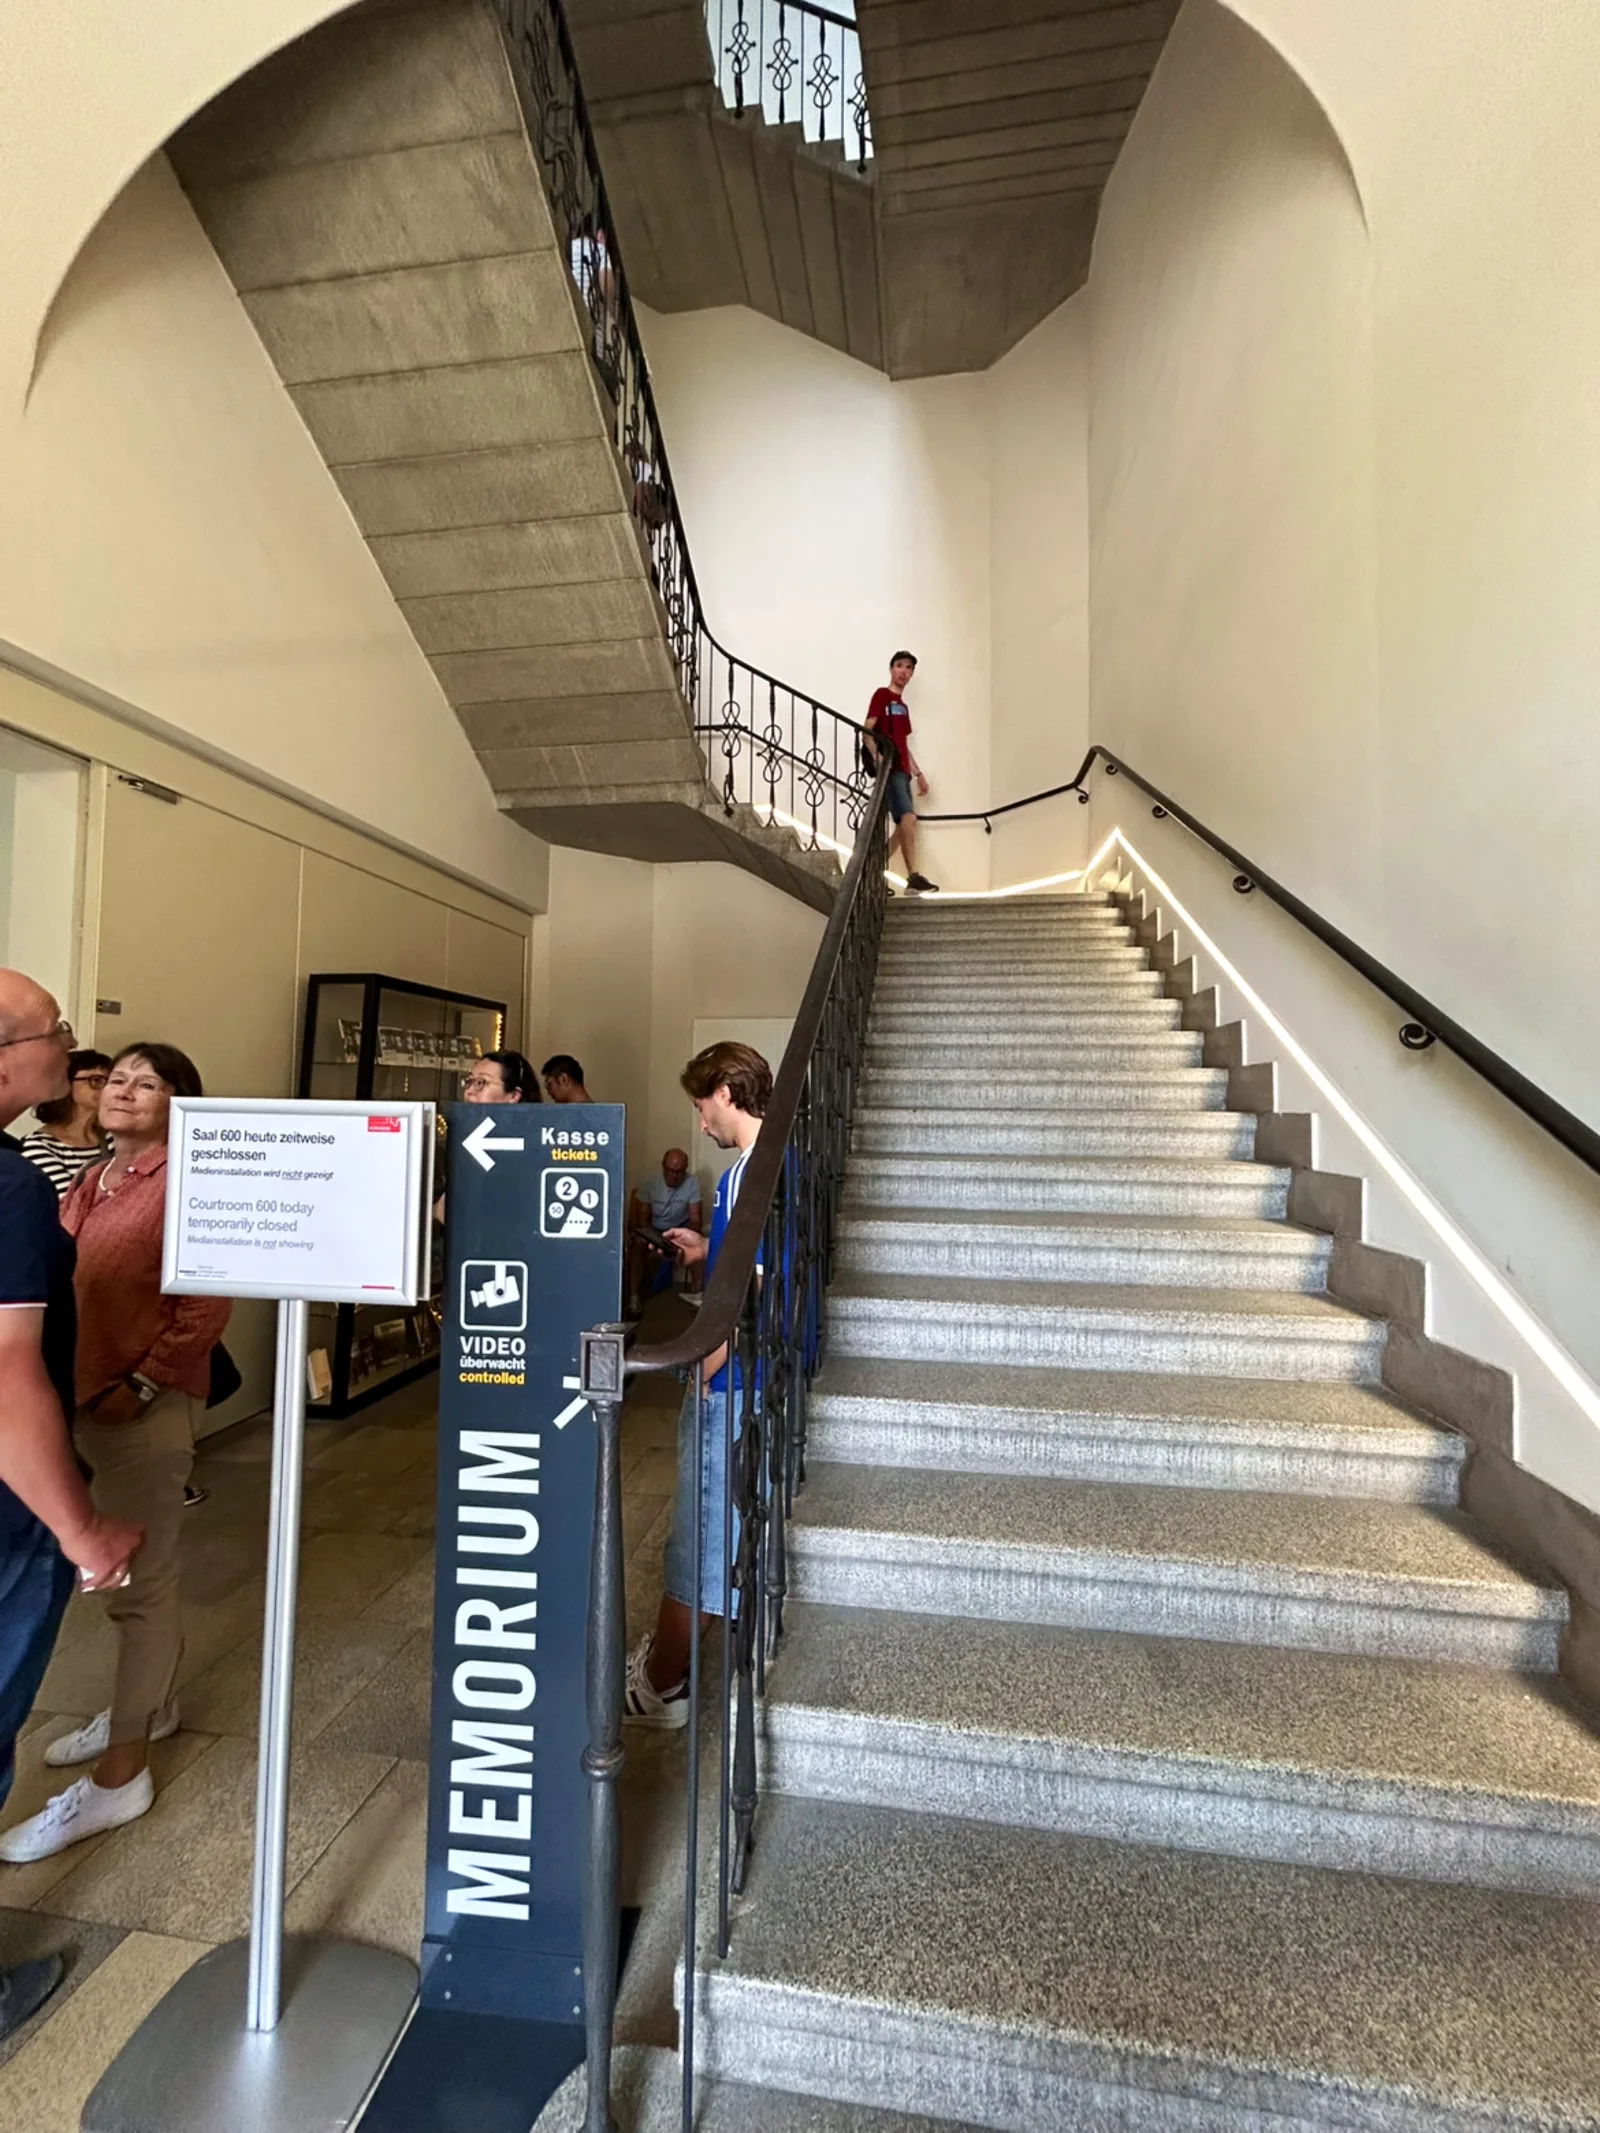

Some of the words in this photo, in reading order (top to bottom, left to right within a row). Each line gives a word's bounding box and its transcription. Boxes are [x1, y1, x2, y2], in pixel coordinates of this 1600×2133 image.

[192, 1128, 217, 1143] Saal
[220, 1130, 241, 1143] 600
[244, 1130, 277, 1144] heute
[279, 1131, 335, 1145] zeitweise
[541, 1127, 610, 1146] Kasse
[191, 1147, 267, 1162] geschlossen
[551, 1148, 598, 1161] tickets
[190, 1166, 262, 1178] Medieninstallation
[263, 1168, 281, 1178] wird
[281, 1169, 303, 1180] nicht
[303, 1170, 334, 1181] gezeigt
[562, 1181, 572, 1196] 2
[586, 1193, 593, 1205] 1
[188, 1197, 253, 1212] Courtroom
[256, 1200, 278, 1213] 600
[280, 1200, 315, 1217] today
[188, 1217, 255, 1233] temporarily
[257, 1219, 298, 1232] closed
[187, 1235, 253, 1247] Mediainstallation
[262, 1239, 277, 1249] not
[278, 1239, 314, 1251] showing
[460, 1336, 526, 1356] VIDEO
[459, 1356, 526, 1371] überwacht
[459, 1371, 525, 1385] controlled
[446, 1429, 541, 1921] MEMORIUM
